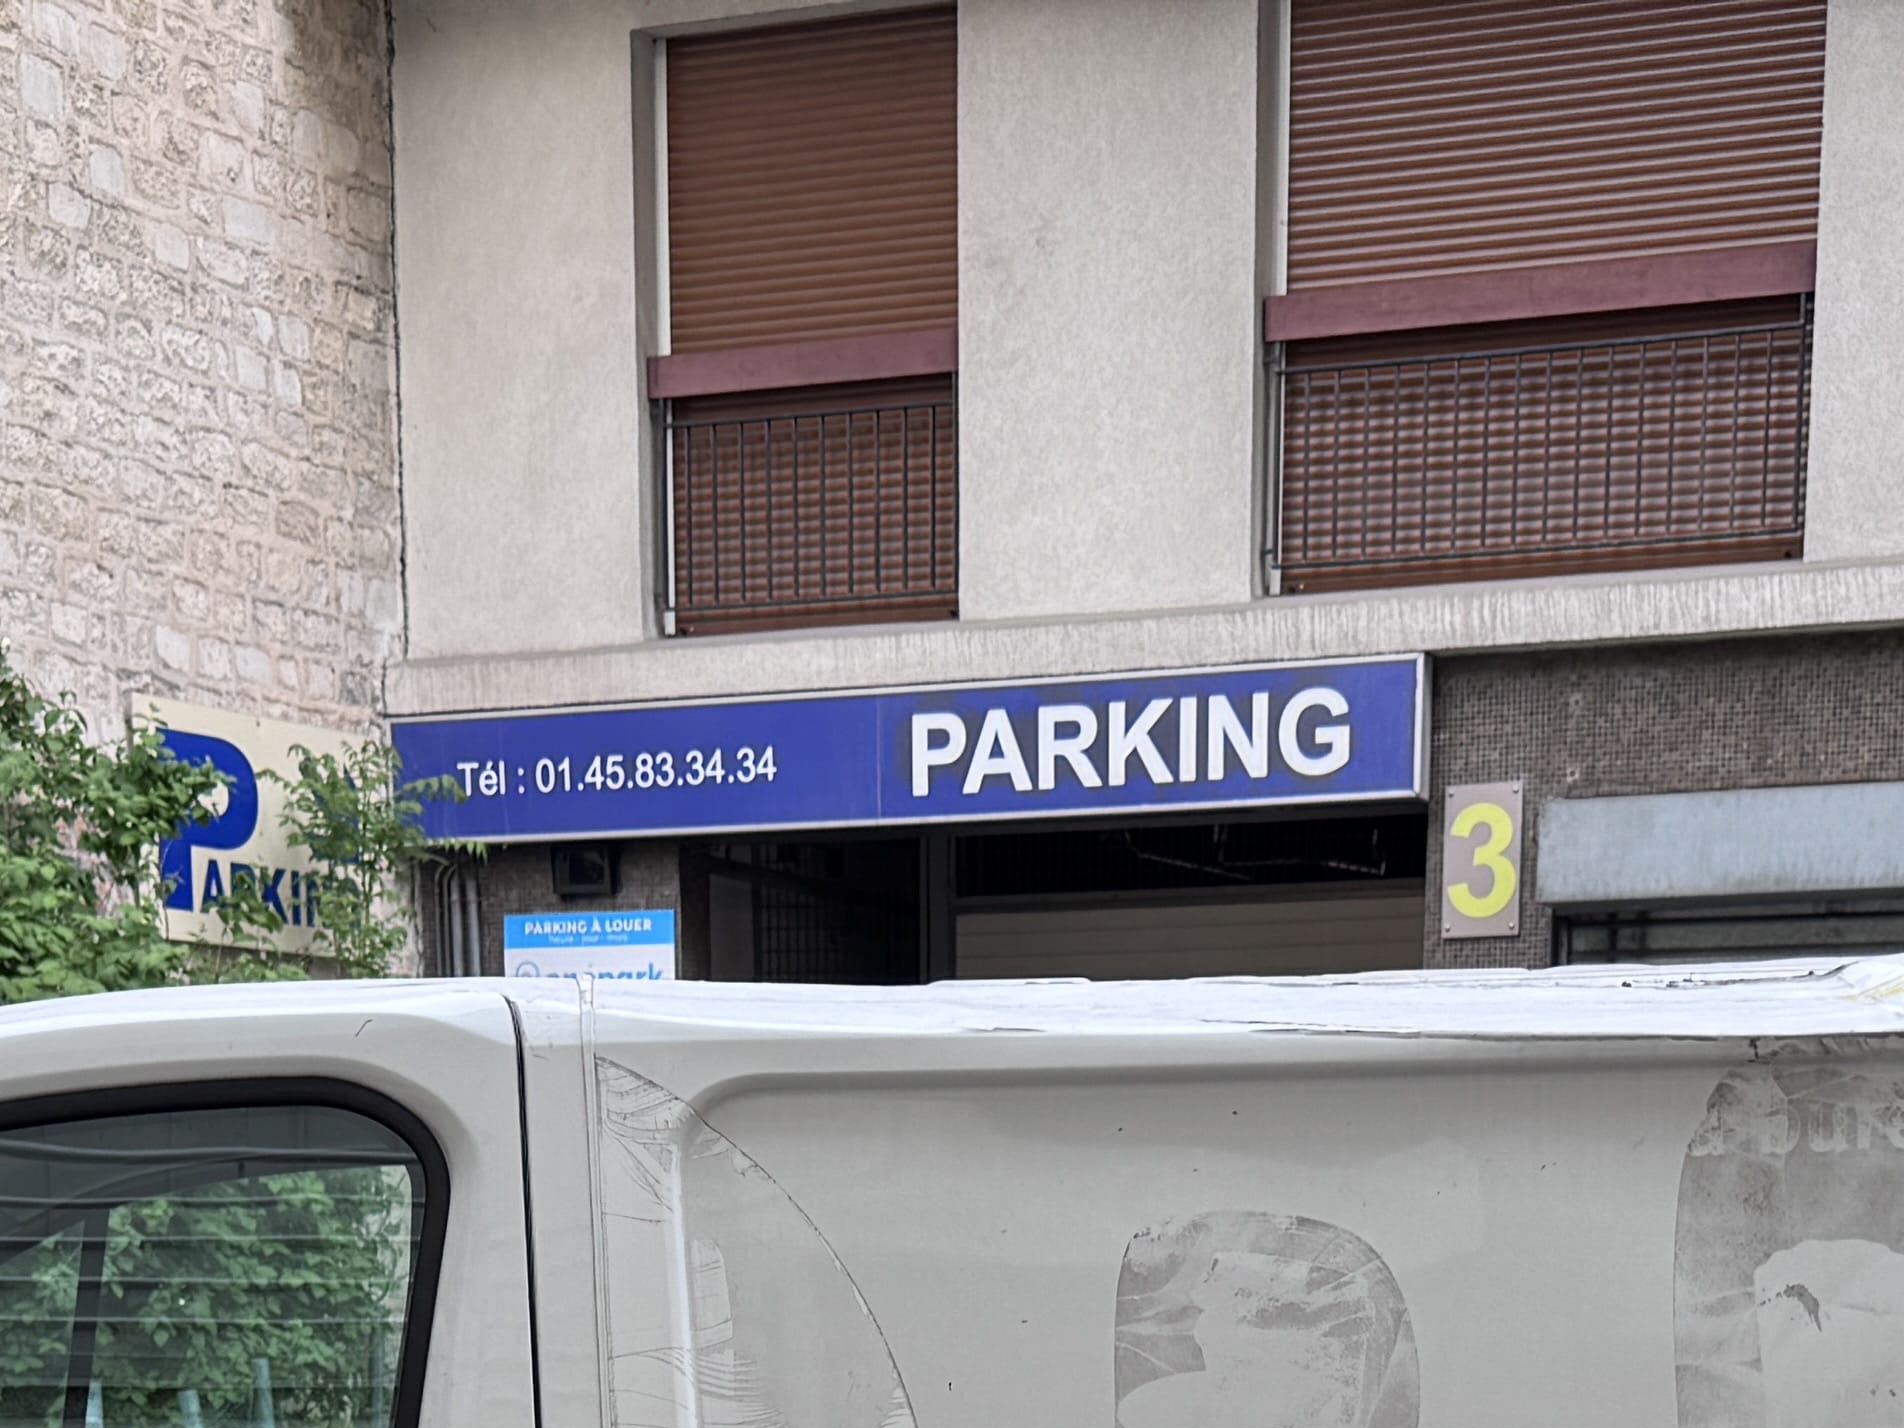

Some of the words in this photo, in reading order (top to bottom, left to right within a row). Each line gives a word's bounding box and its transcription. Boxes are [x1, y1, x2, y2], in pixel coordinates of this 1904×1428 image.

[456, 759, 507, 797] Tél
[534, 744, 778, 794] 01.45.83.34.34
[910, 687, 1352, 798] PARKING
[1446, 801, 1517, 919] 3
[524, 919, 587, 936] PARKING
[590, 915, 602, 933] À
[605, 917, 653, 933] LOUER
